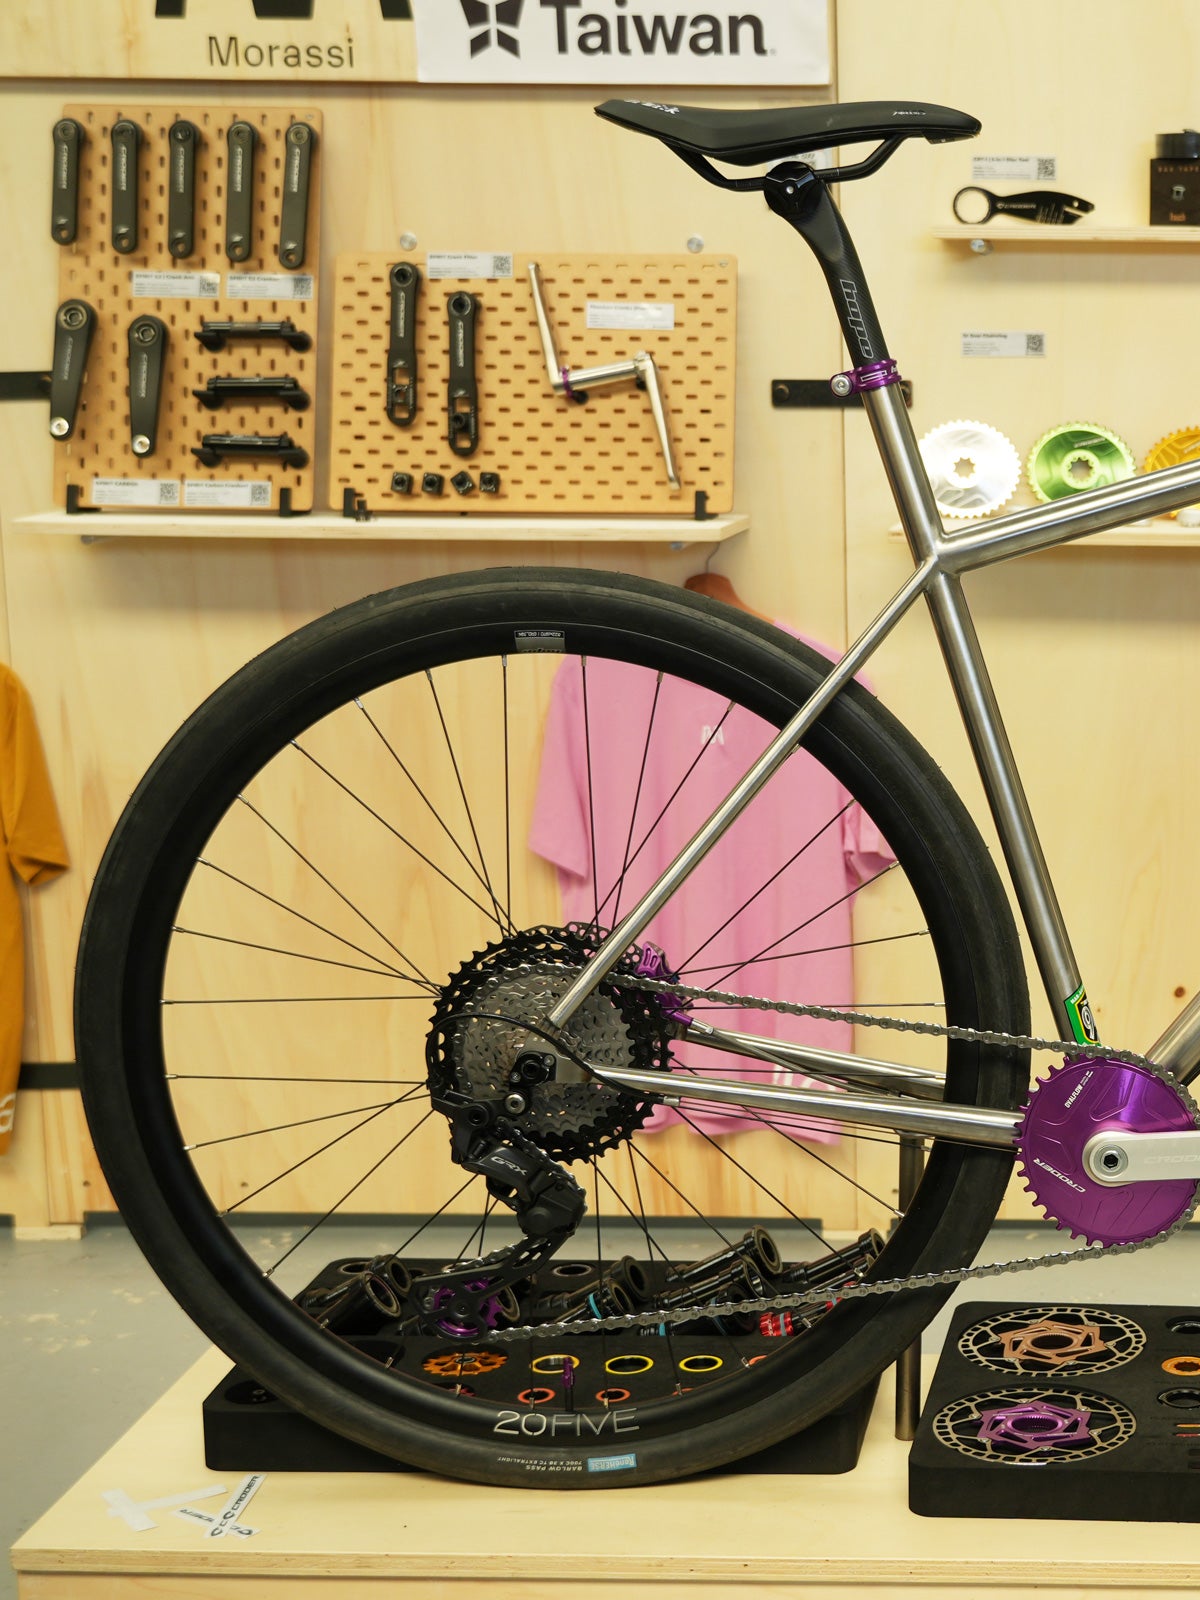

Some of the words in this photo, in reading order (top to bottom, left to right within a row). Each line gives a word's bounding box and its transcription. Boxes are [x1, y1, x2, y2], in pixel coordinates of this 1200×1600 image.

[539, 0, 768, 57] Taiwan
[208, 36, 354, 68] Morassi
[840, 279, 874, 358] hope
[491, 1156, 528, 1176] GRX
[1033, 1158, 1086, 1193] CRODER
[493, 1408, 640, 1437] 20FIVE
[232, 1475, 260, 1511] CRODER
